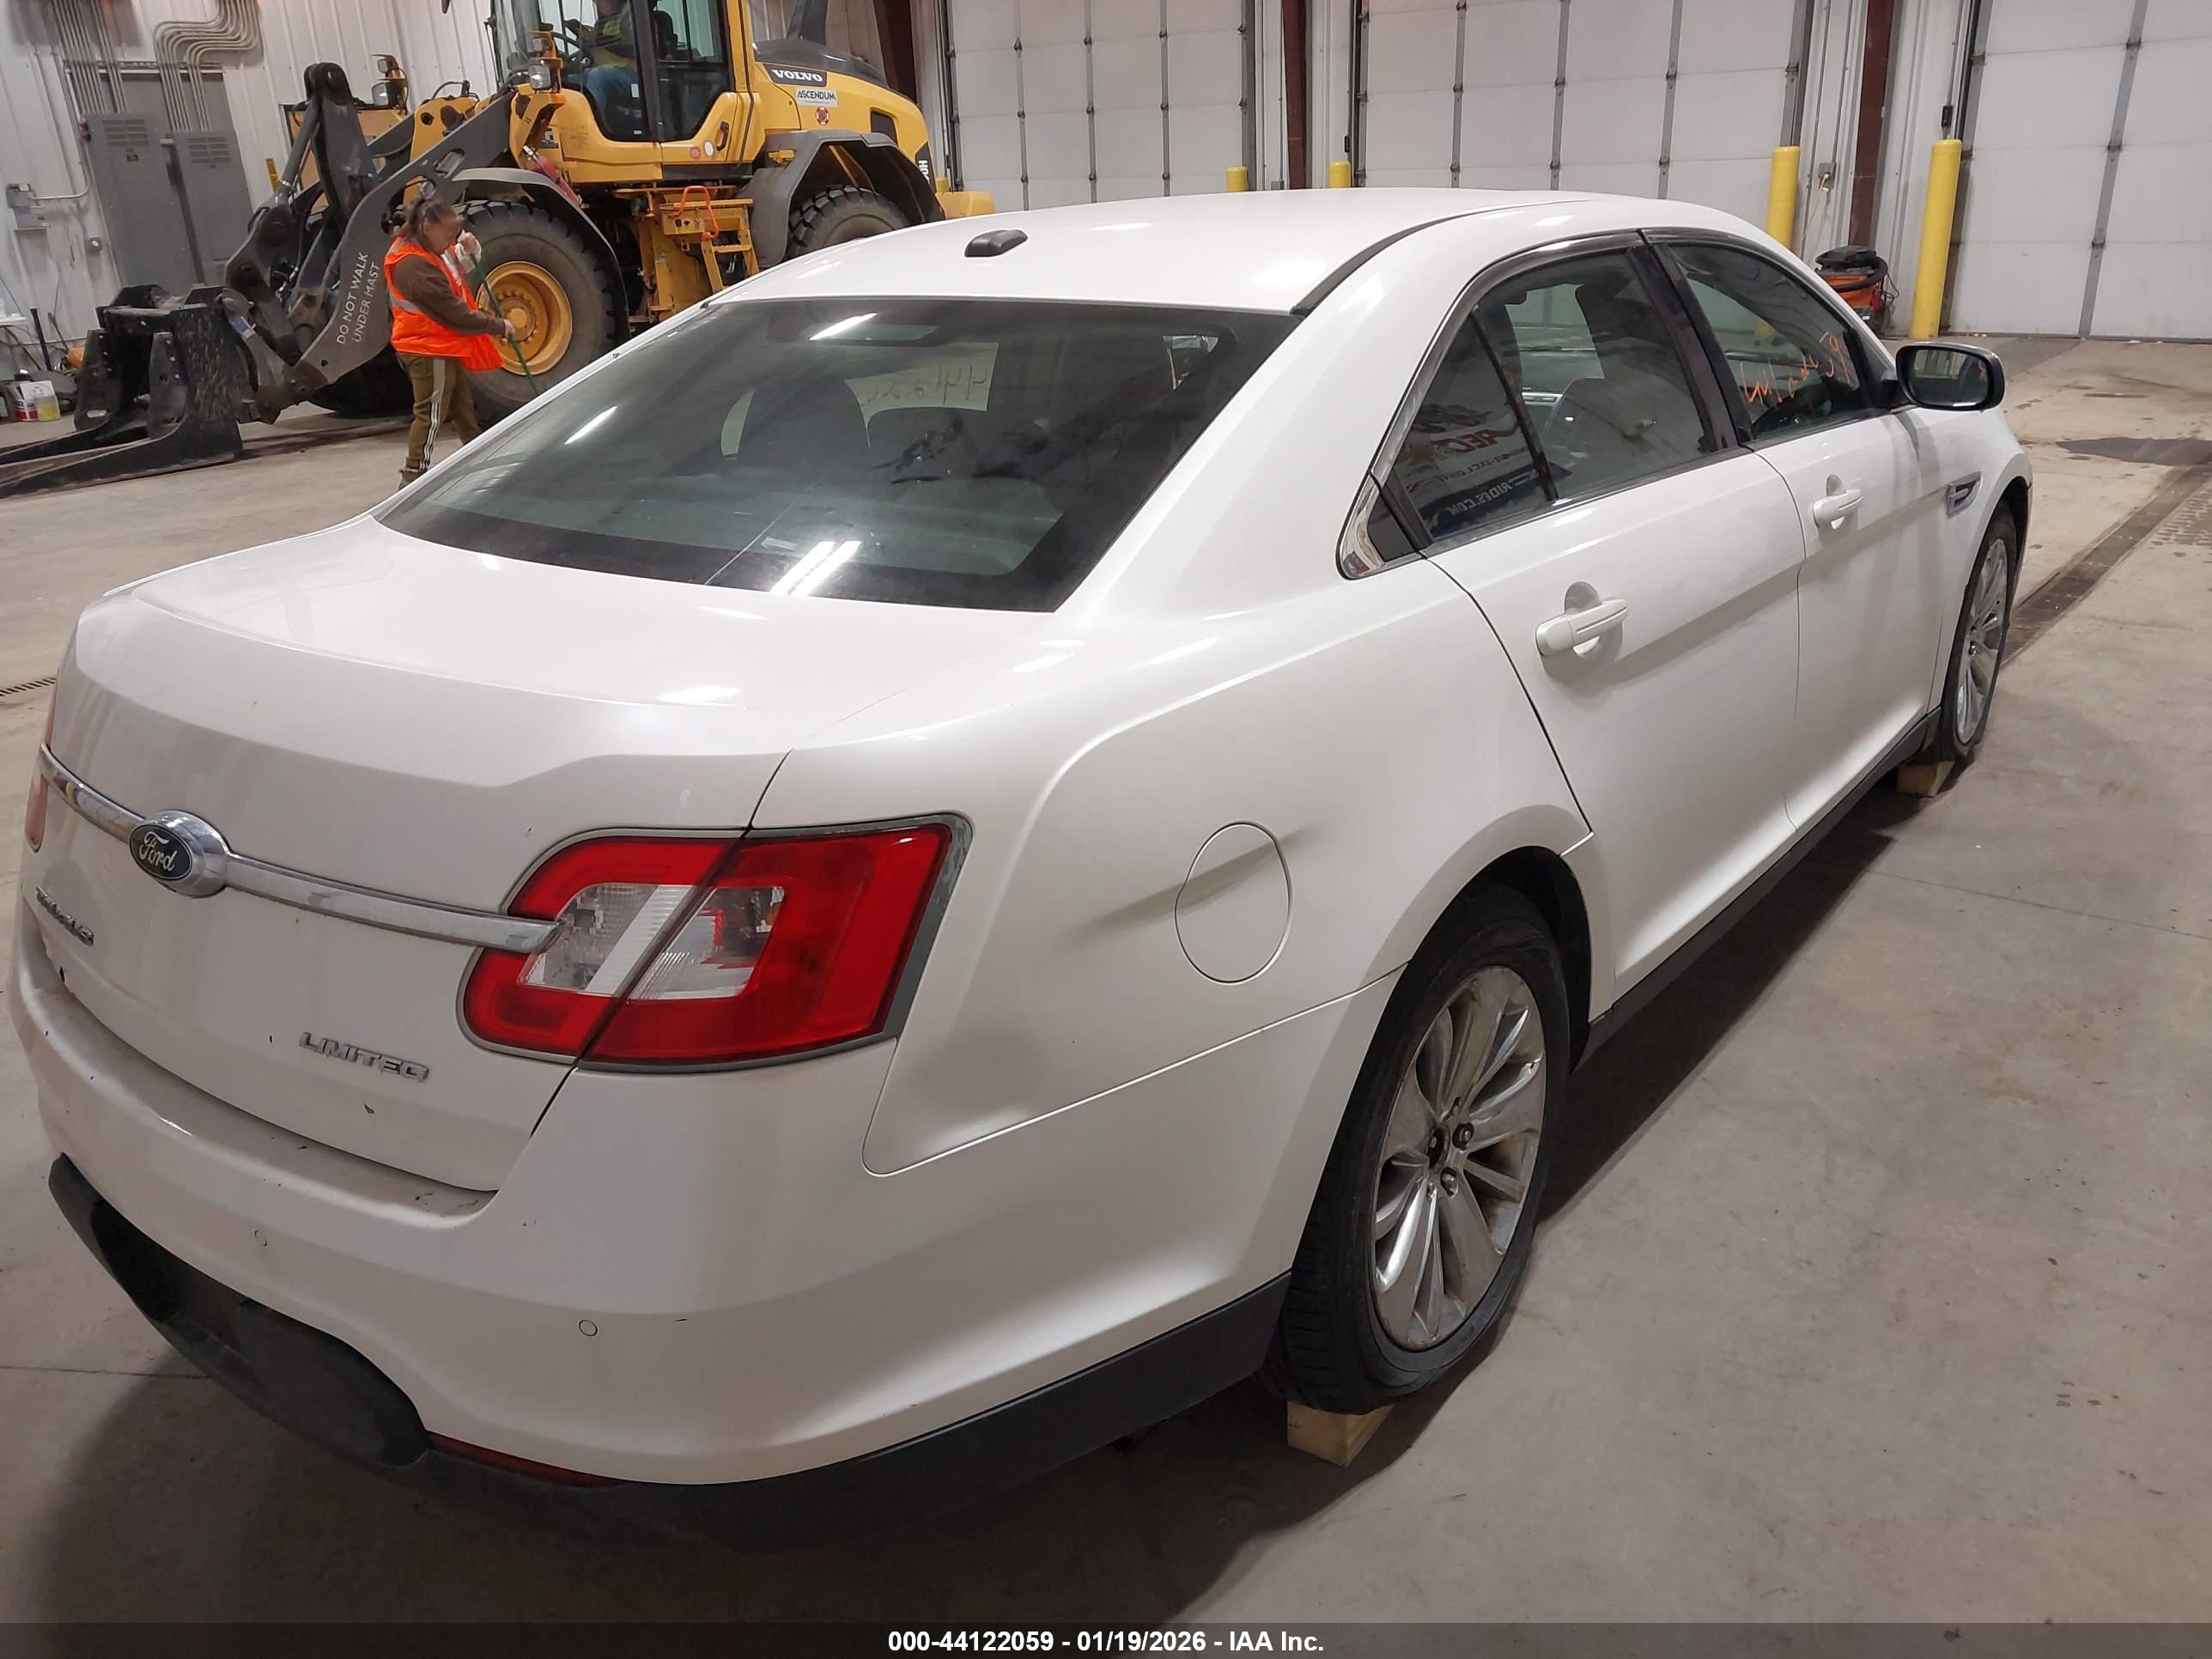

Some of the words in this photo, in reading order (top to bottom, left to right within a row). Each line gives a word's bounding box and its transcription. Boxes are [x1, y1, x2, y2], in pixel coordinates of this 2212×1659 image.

[771, 70, 823, 82] VOLVO
[797, 89, 836, 100] ASCENDUM
[349, 252, 369, 289] WALK
[343, 291, 357, 322] NOT
[352, 300, 371, 343] UNDER
[364, 261, 380, 298] MAST
[336, 324, 349, 344] DO
[139, 830, 179, 872] Ford
[299, 1031, 429, 1082] LIMITED
